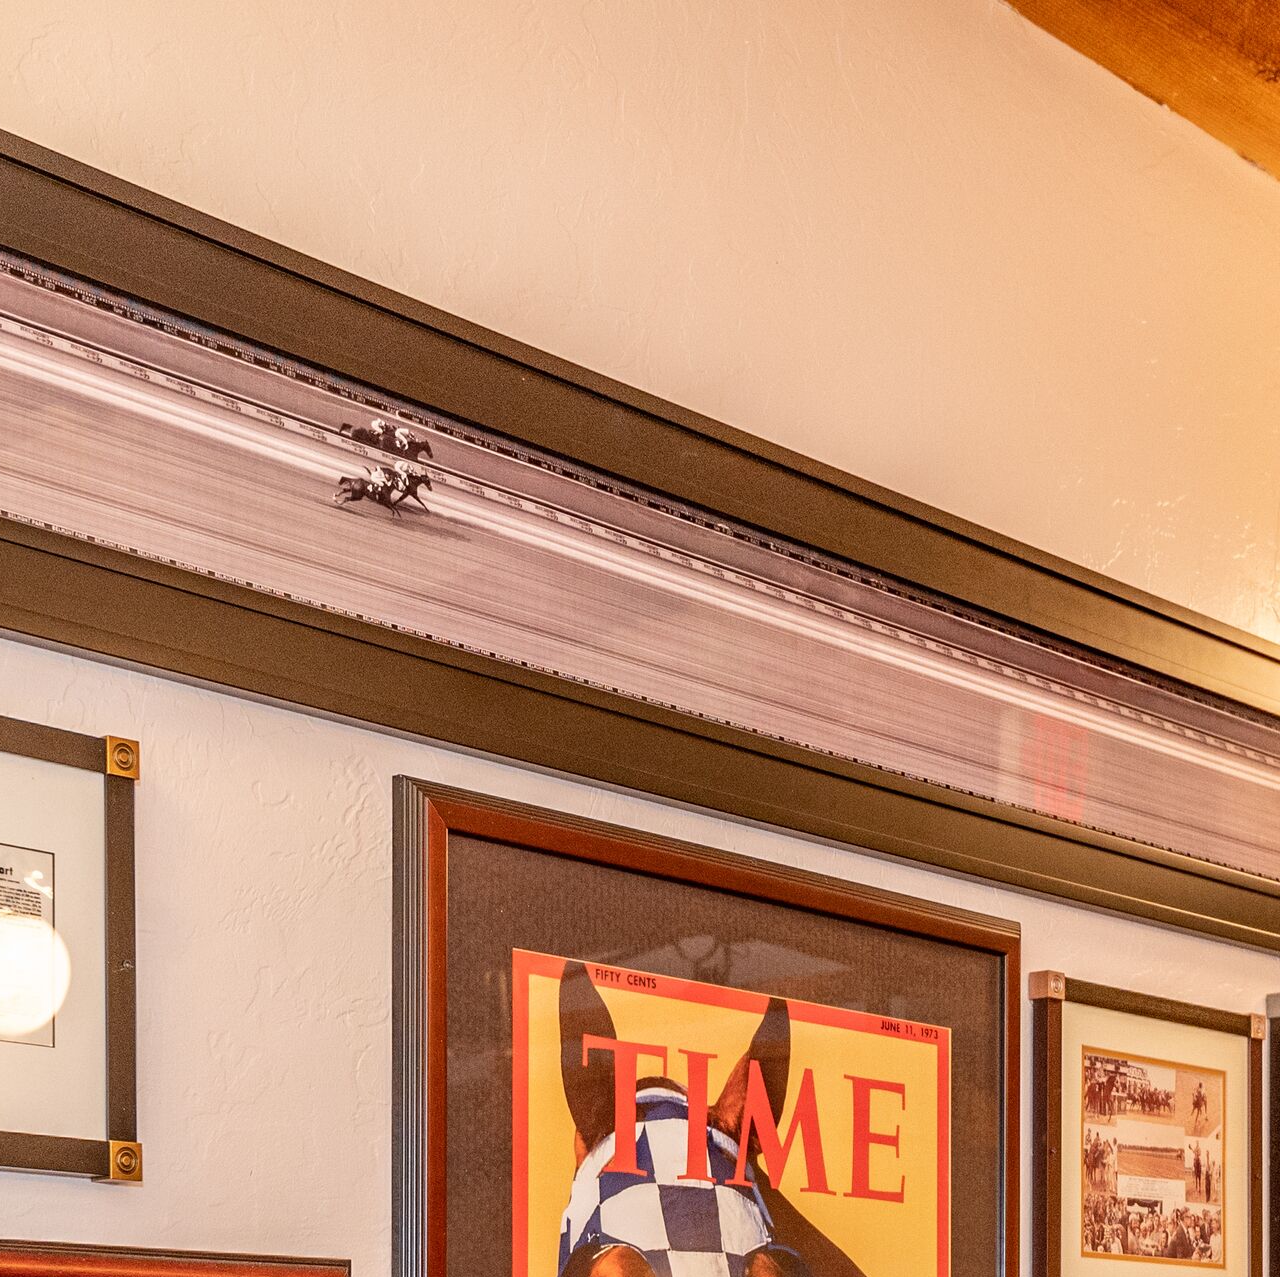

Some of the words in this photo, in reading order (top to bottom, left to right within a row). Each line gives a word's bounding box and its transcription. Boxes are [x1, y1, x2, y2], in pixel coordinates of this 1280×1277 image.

[595, 969, 621, 983] FIFTY
[627, 974, 657, 990] CENTS
[880, 1020, 901, 1033] JUNE
[905, 1025, 916, 1038] 11,
[920, 1027, 938, 1040] 1973
[582, 1033, 905, 1203] TIME
